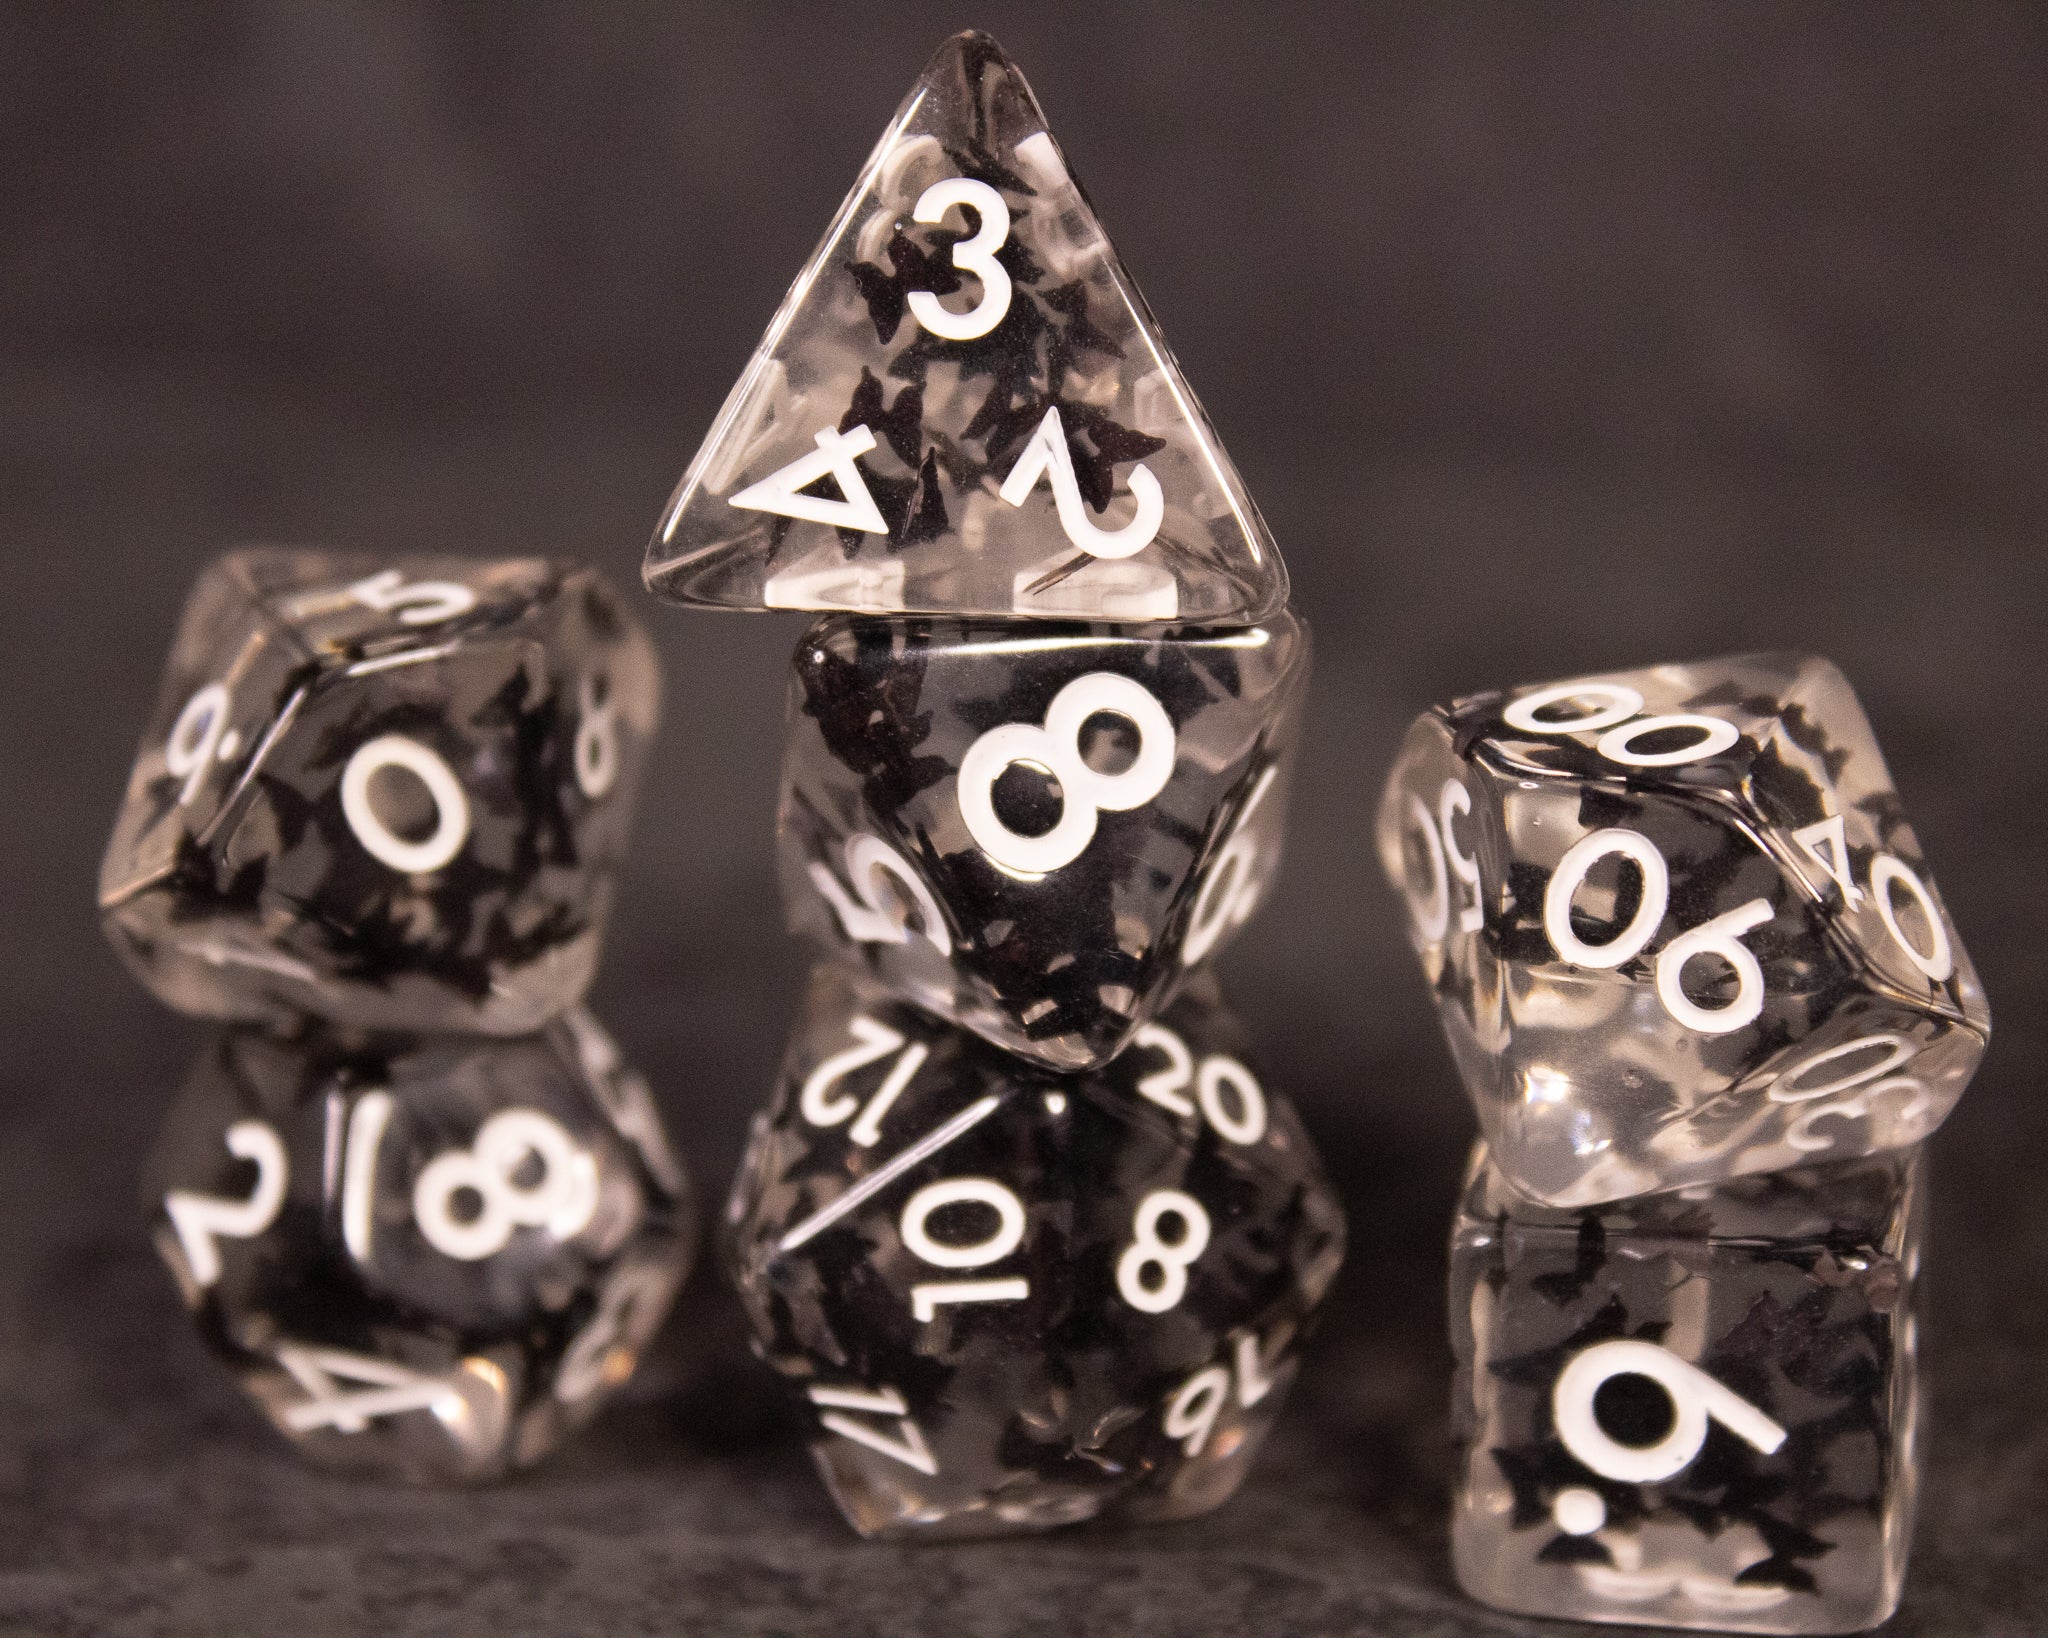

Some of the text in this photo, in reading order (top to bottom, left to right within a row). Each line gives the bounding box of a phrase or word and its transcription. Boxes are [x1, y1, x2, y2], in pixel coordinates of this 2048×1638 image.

[907, 178, 1012, 341] 3
[728, 423, 889, 534] 4
[999, 405, 1165, 559] 2
[956, 672, 1176, 876] 8
[1502, 683, 1740, 766] 00
[341, 734, 470, 874] 0
[1791, 813, 1952, 982] 40
[800, 1015, 930, 1148] 12
[1133, 1022, 1268, 1145] 20
[165, 1119, 289, 1288] 2
[413, 1109, 582, 1261] 8
[900, 1177, 1030, 1324] 10
[1115, 1190, 1211, 1314] 8
[808, 1384, 938, 1476] 17
